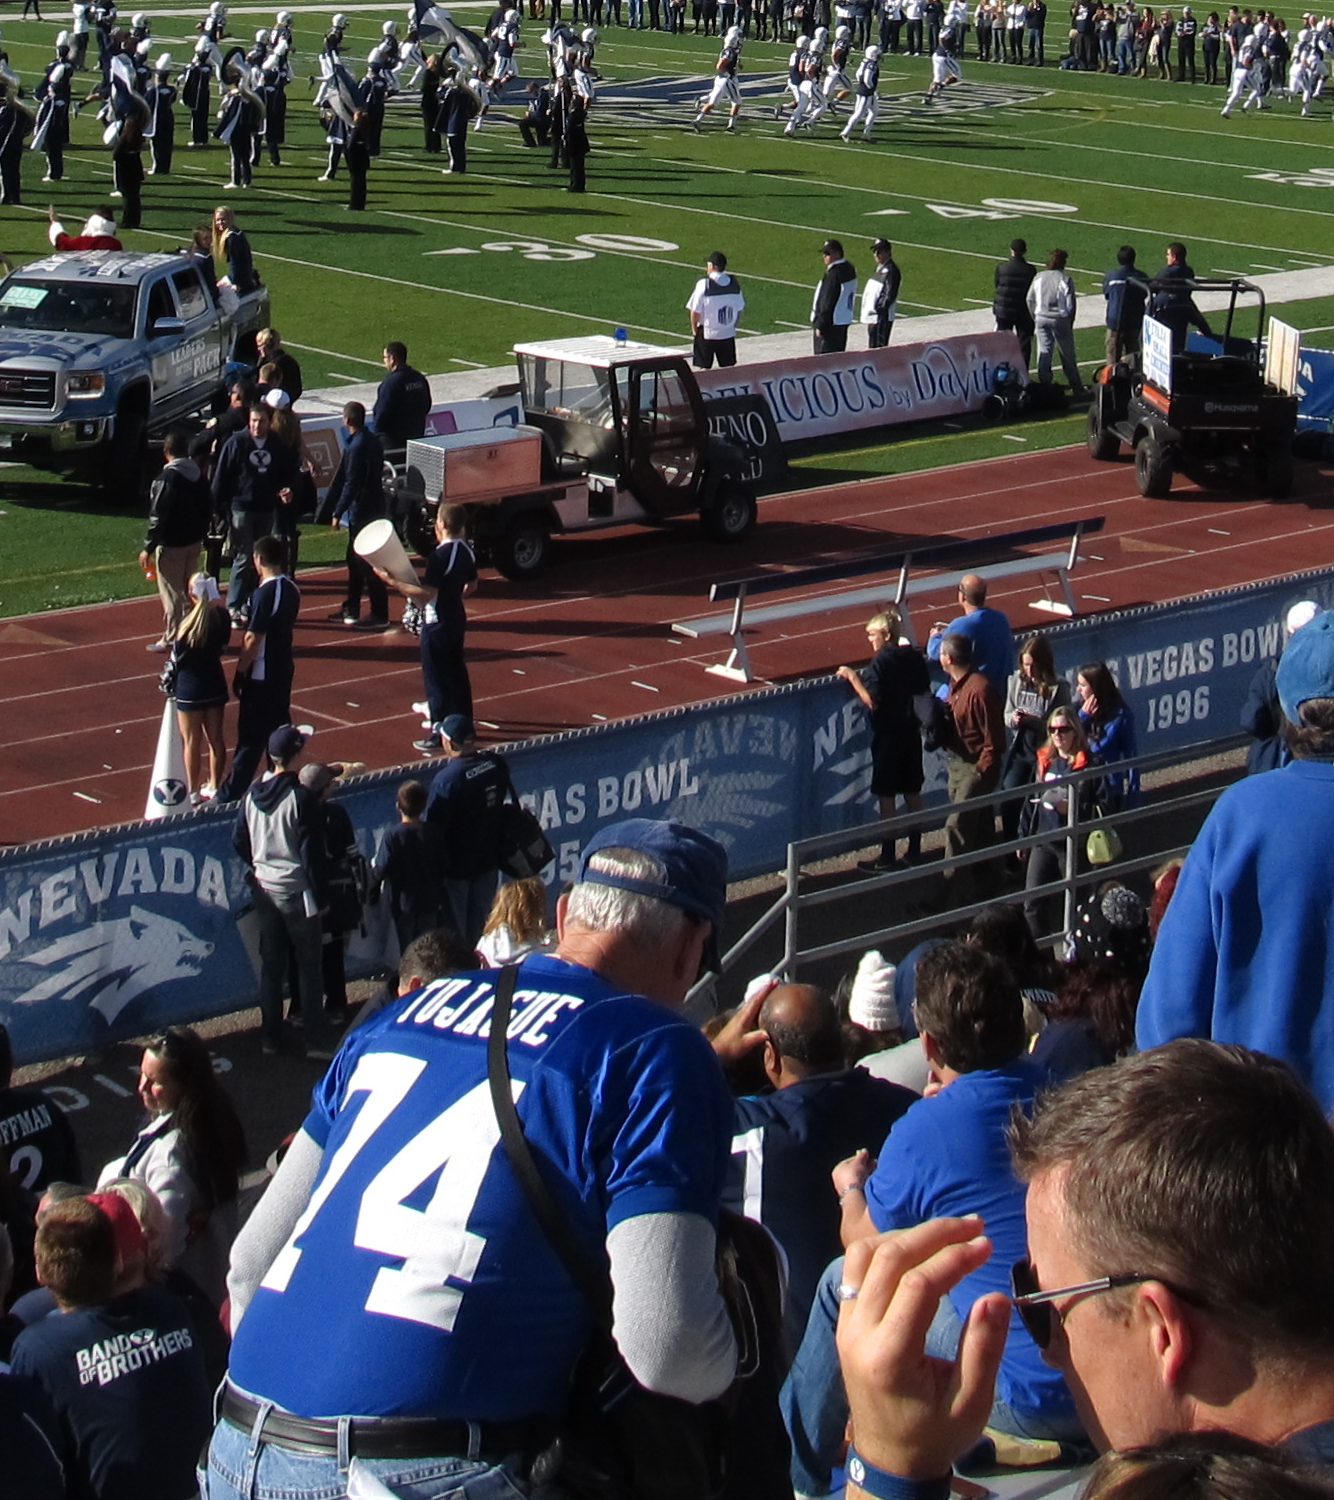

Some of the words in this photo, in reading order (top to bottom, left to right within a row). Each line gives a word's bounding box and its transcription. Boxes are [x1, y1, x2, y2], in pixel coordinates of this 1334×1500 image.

[481, 233, 680, 261] 30
[890, 385, 916, 409] by
[910, 345, 999, 408] DaVit
[1127, 637, 1215, 690] VEGAS
[1147, 685, 1211, 733] 1996
[597, 758, 699, 818] BOWL
[9, 1144, 44, 1190] 2
[260, 1050, 526, 1332] 74
[75, 1332, 134, 1372] BAND
[78, 1366, 98, 1387] OF
[96, 1327, 194, 1387] BROTHERS
